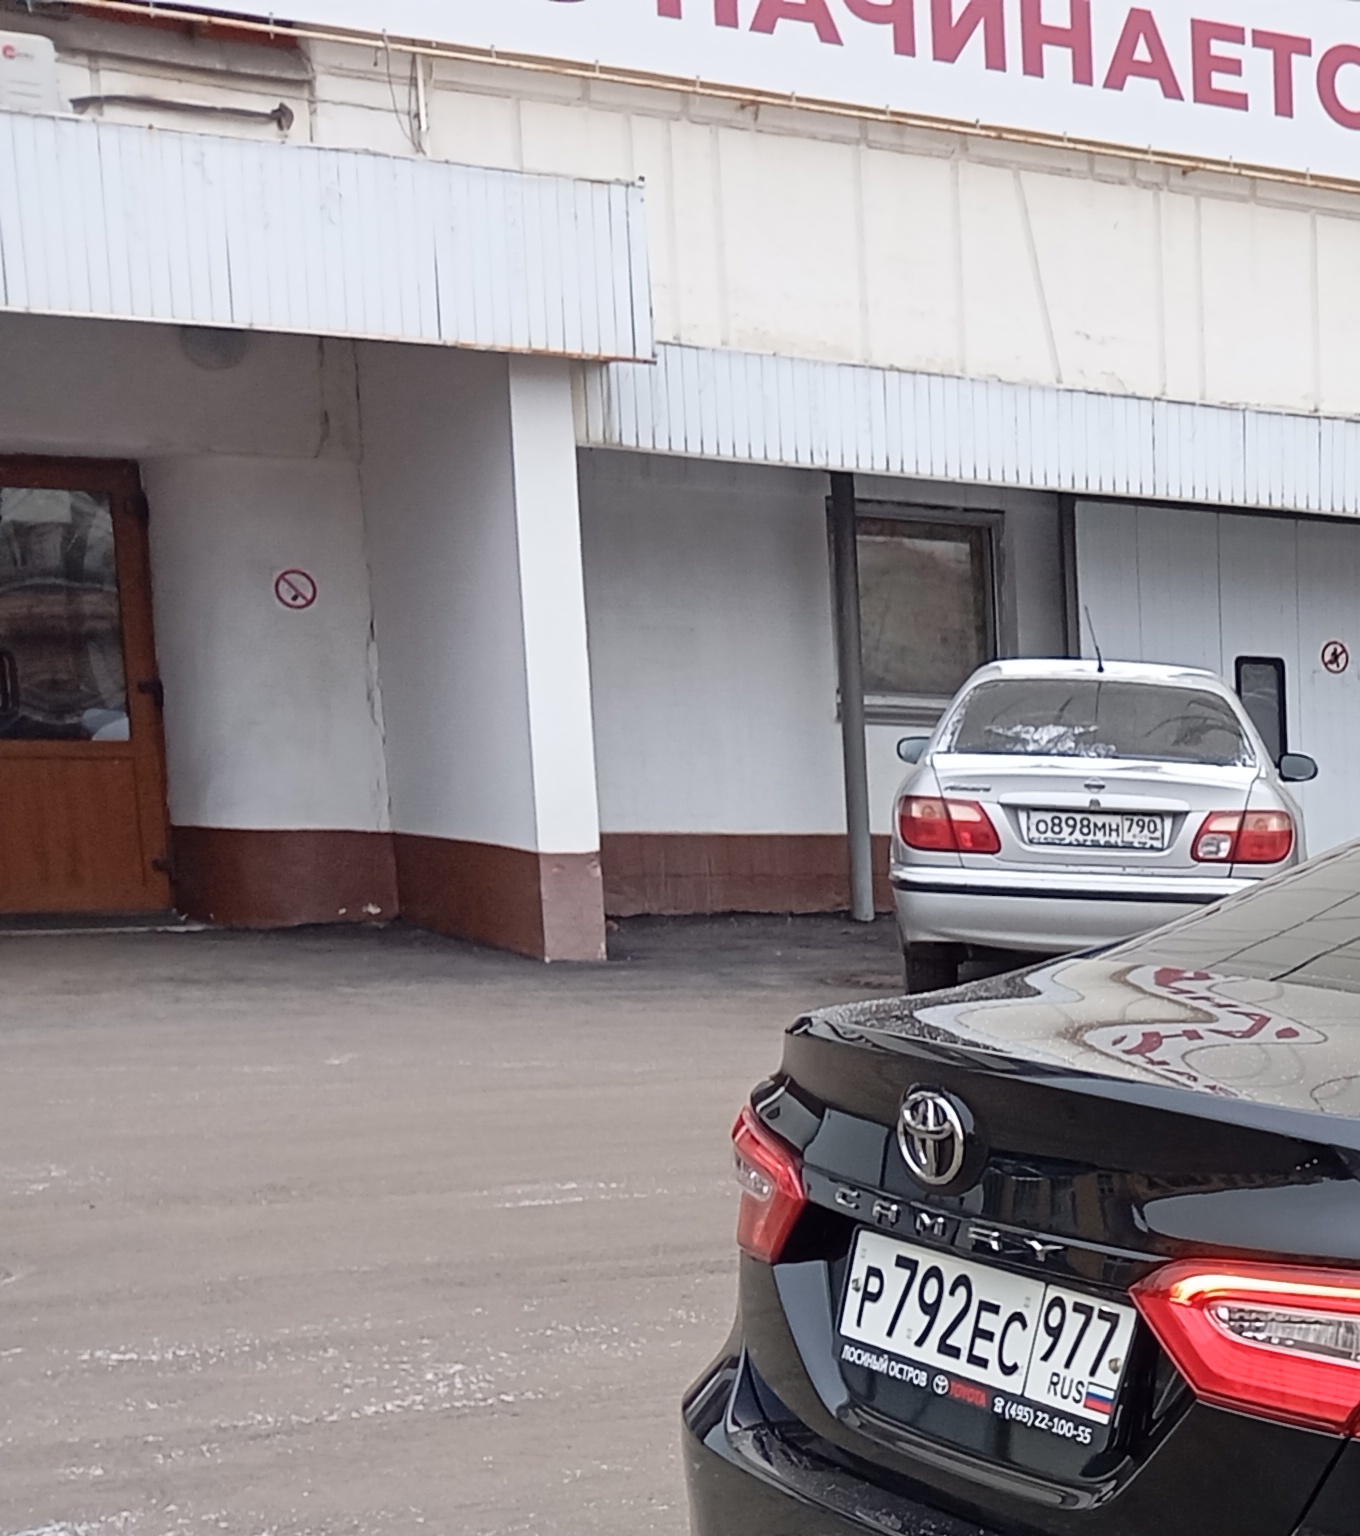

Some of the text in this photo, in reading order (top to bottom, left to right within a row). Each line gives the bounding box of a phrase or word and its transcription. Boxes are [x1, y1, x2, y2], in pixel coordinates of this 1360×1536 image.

[1035, 815, 1159, 837] О898МН 790
[834, 1186, 1066, 1262] CAMRY
[856, 1253, 1121, 1378] Р792ЕС 977
[841, 1344, 1093, 1445] ЛОСИНЫЙ ОСТРОВ TOYOTA (495) 22-100-55
[1047, 1371, 1086, 1405] RUS
